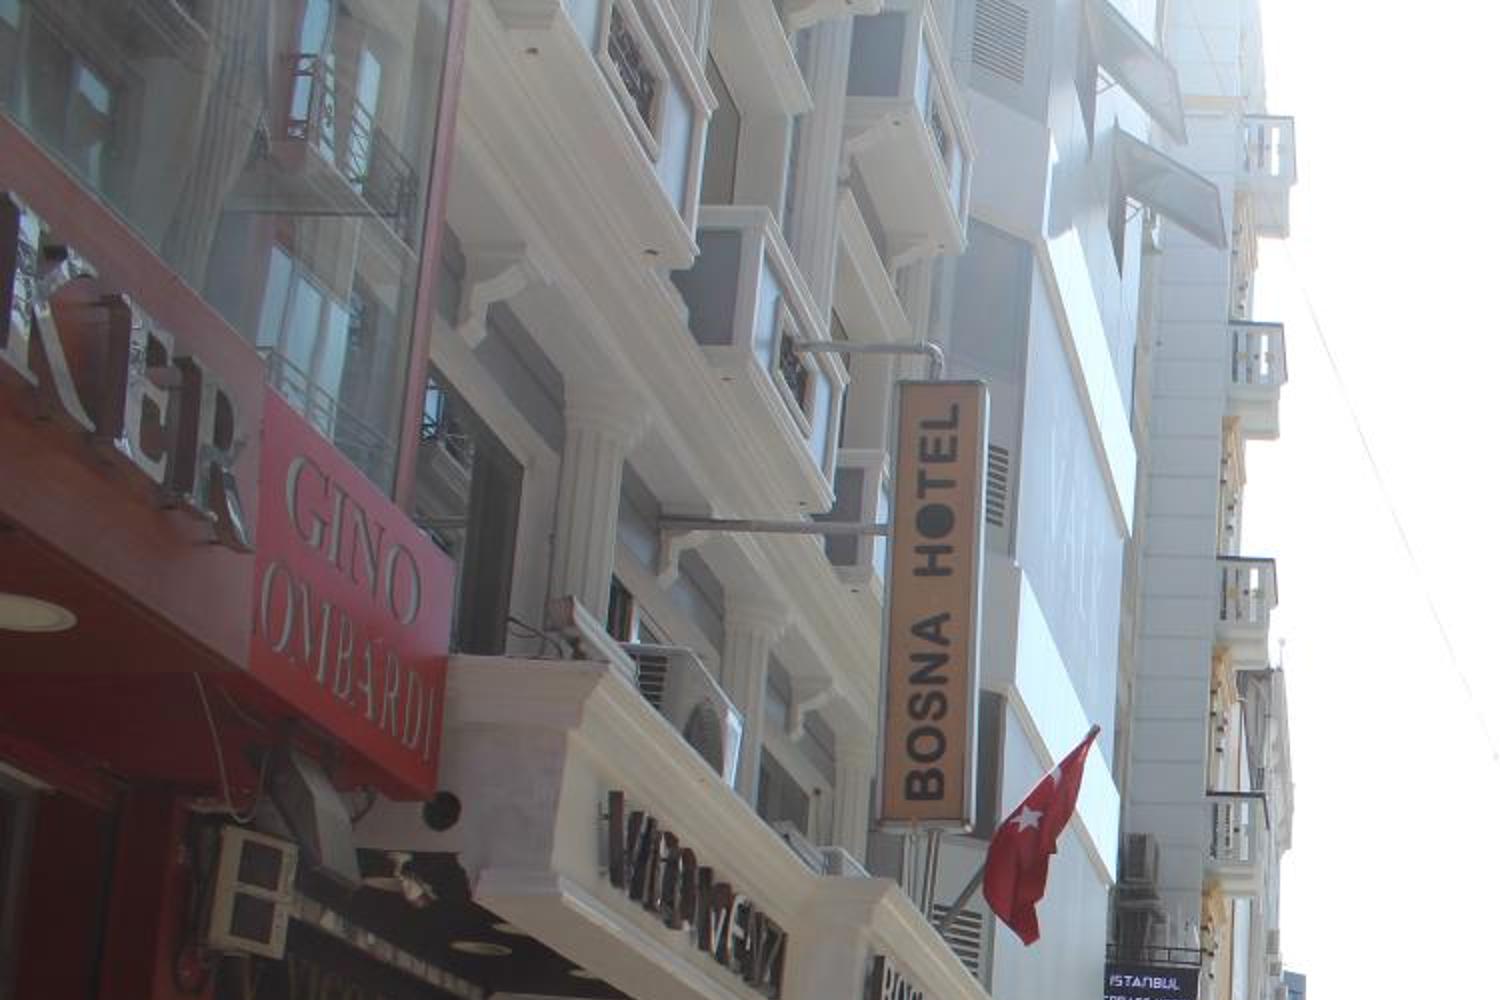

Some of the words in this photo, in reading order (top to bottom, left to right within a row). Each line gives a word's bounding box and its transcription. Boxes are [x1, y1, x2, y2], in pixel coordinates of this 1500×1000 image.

[286, 456, 421, 625] GINO
[913, 403, 959, 577] HOTEL
[904, 612, 950, 801] BOSNA
[1109, 975, 1181, 991] ISTANBUL
